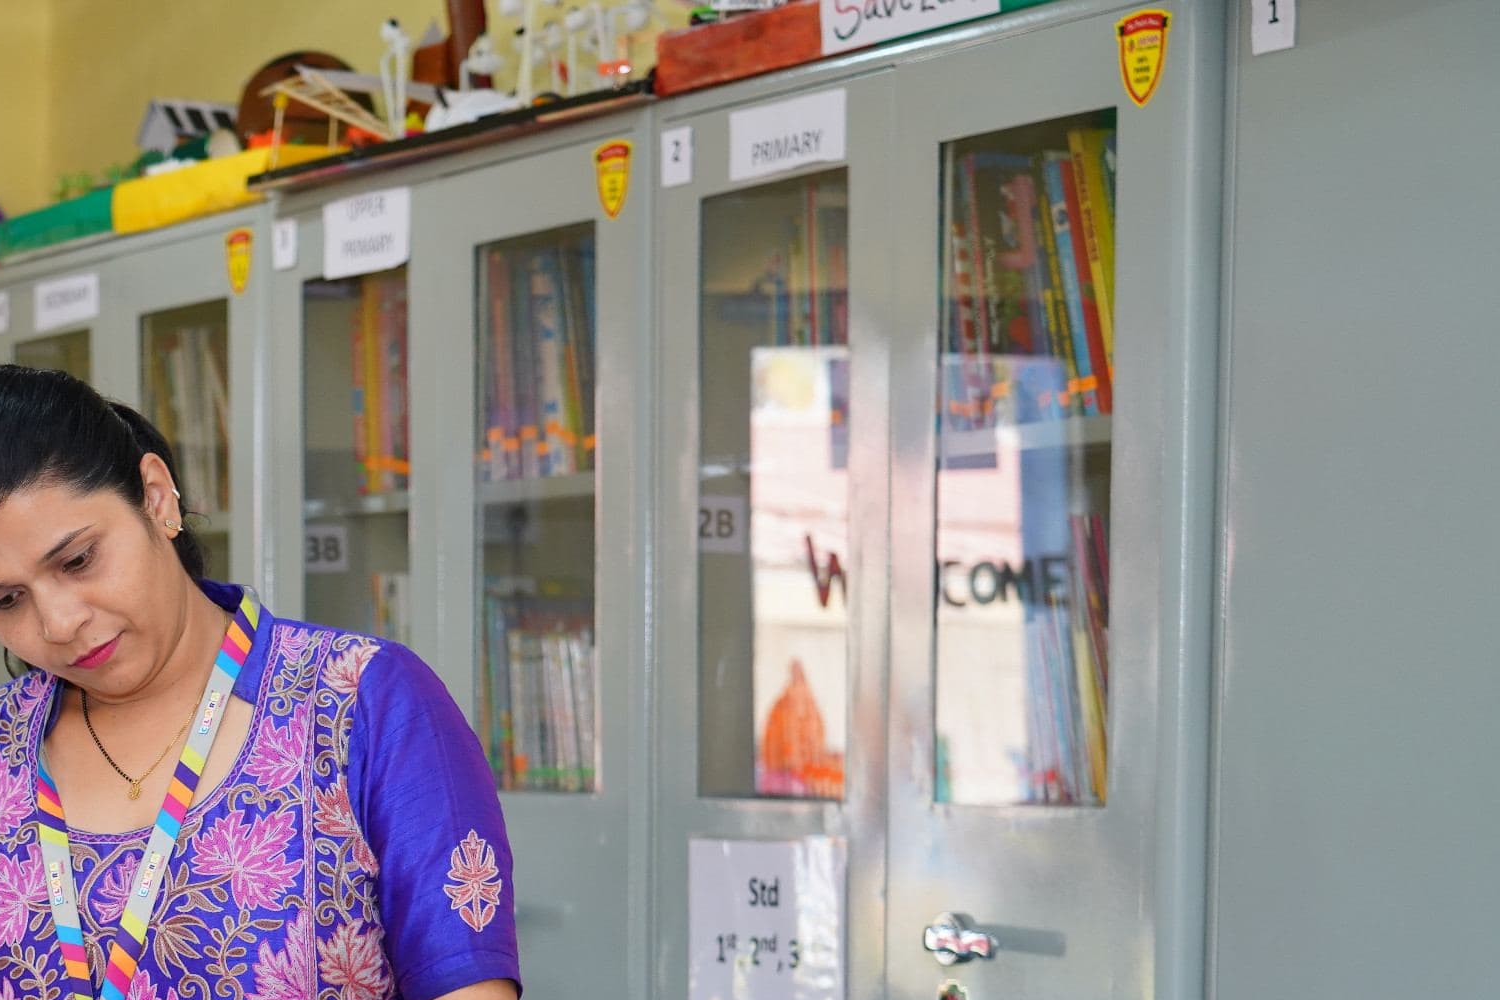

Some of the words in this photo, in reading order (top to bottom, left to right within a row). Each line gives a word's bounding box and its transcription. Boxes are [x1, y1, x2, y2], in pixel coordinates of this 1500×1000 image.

[1268, 0, 1280, 24] 1
[672, 140, 681, 162] 2
[750, 129, 824, 167] PRIMARY
[699, 508, 734, 539] 2B
[748, 876, 779, 907] Std
